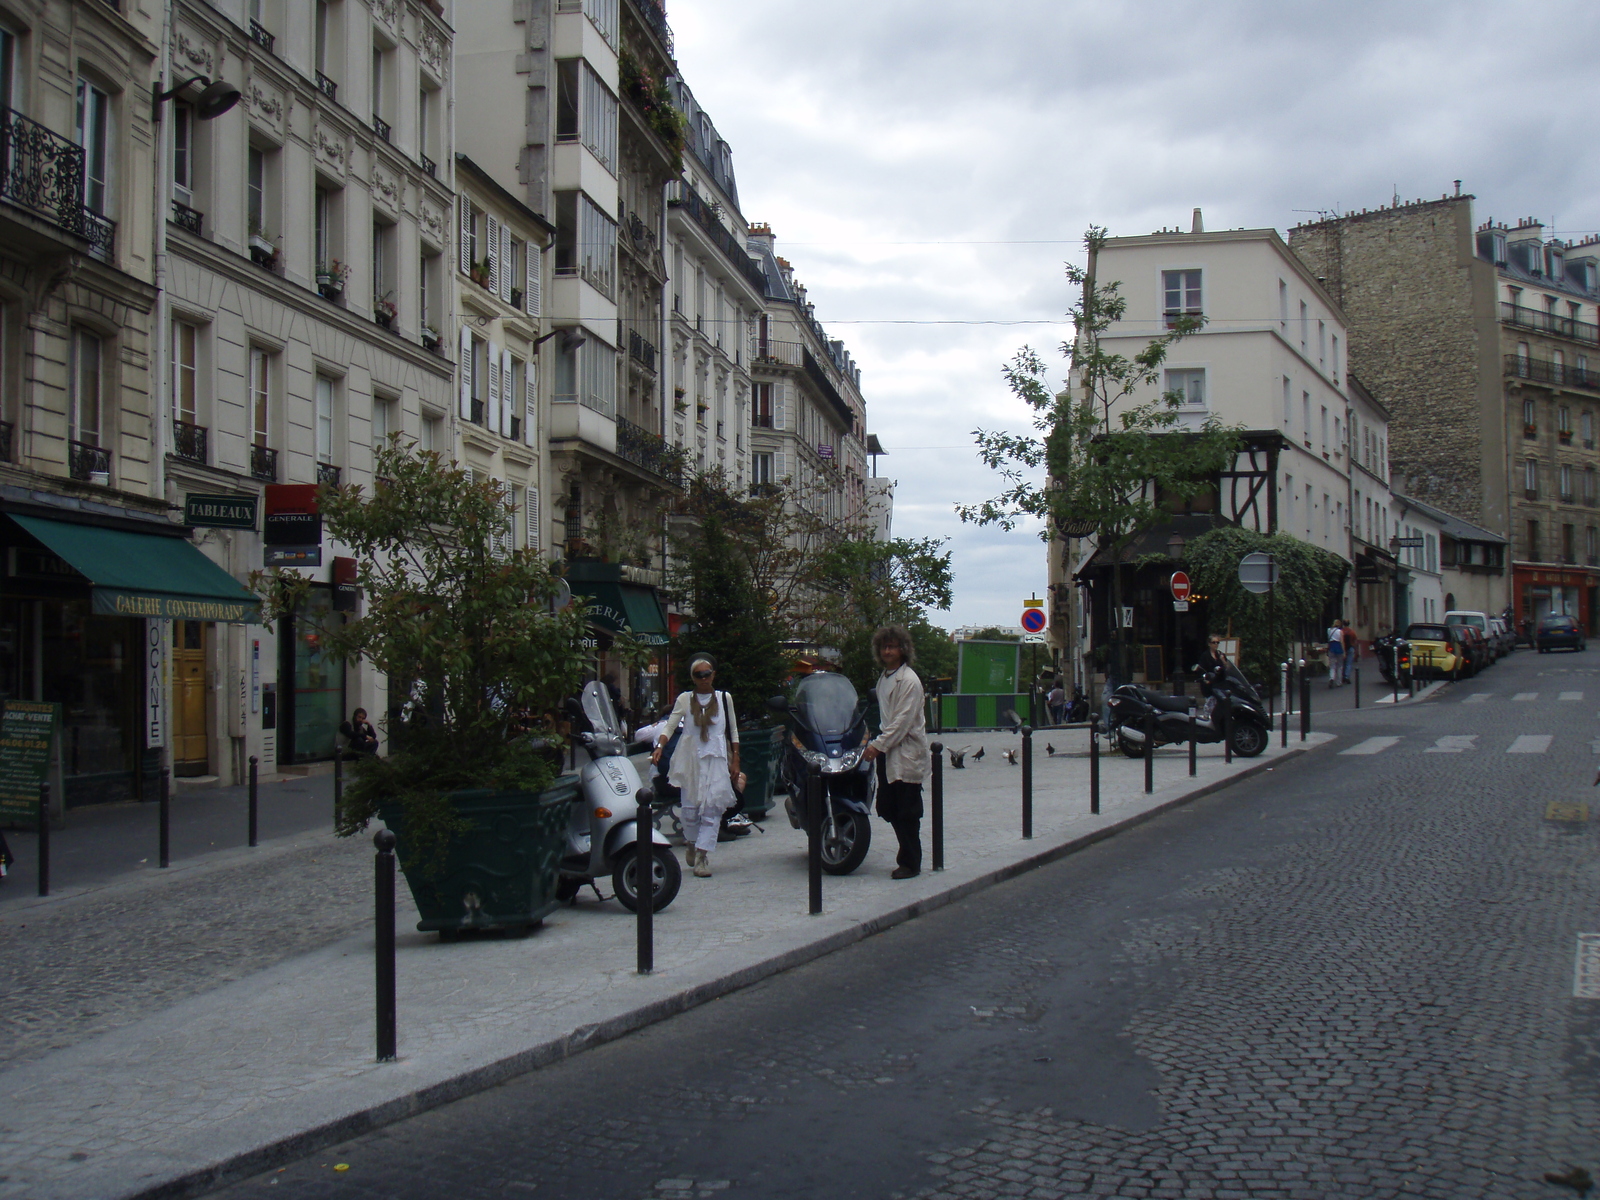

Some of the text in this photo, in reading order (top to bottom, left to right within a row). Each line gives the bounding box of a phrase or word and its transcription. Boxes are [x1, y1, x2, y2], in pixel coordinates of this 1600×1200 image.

[190, 503, 252, 521] TABLEAUX
[116, 594, 245, 621] GALERIE CONTEMPORAINE
[580, 604, 626, 628] ZERIA
